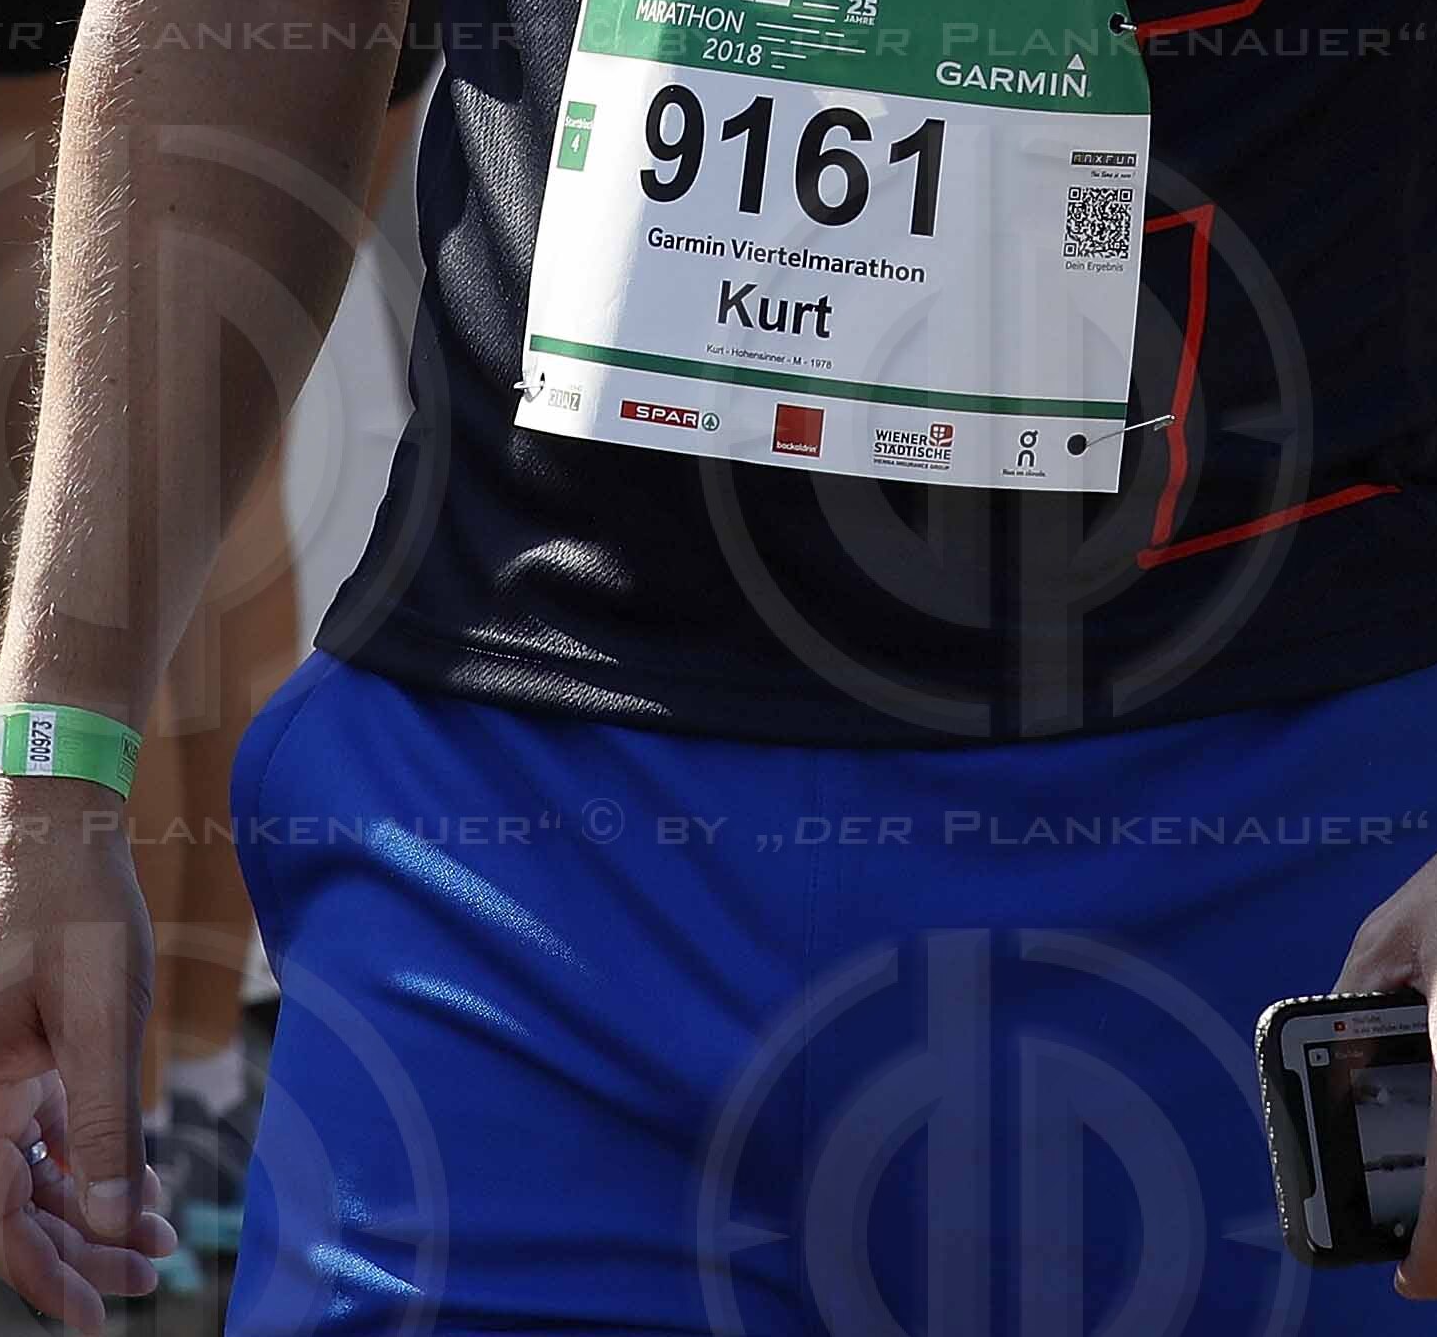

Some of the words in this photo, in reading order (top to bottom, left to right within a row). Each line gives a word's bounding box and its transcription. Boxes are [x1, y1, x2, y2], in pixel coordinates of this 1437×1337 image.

[844, 13, 876, 26] JAHRE
[703, 37, 763, 67] 2018
[935, 59, 1088, 99] GARMIN
[571, 133, 581, 154] 4
[639, 84, 946, 239] 9161
[648, 227, 725, 257] Garmin
[731, 239, 925, 284] Viertelmarathon
[1065, 260, 1085, 271] Dein
[1087, 261, 1124, 272] Ergebnis
[717, 280, 833, 339] Kurt
[706, 345, 724, 355] Kurt
[793, 356, 802, 366] M
[810, 357, 832, 370] 1978
[636, 406, 697, 426] SPAR
[875, 429, 928, 446] WIENER
[30, 720, 53, 763] 00973
